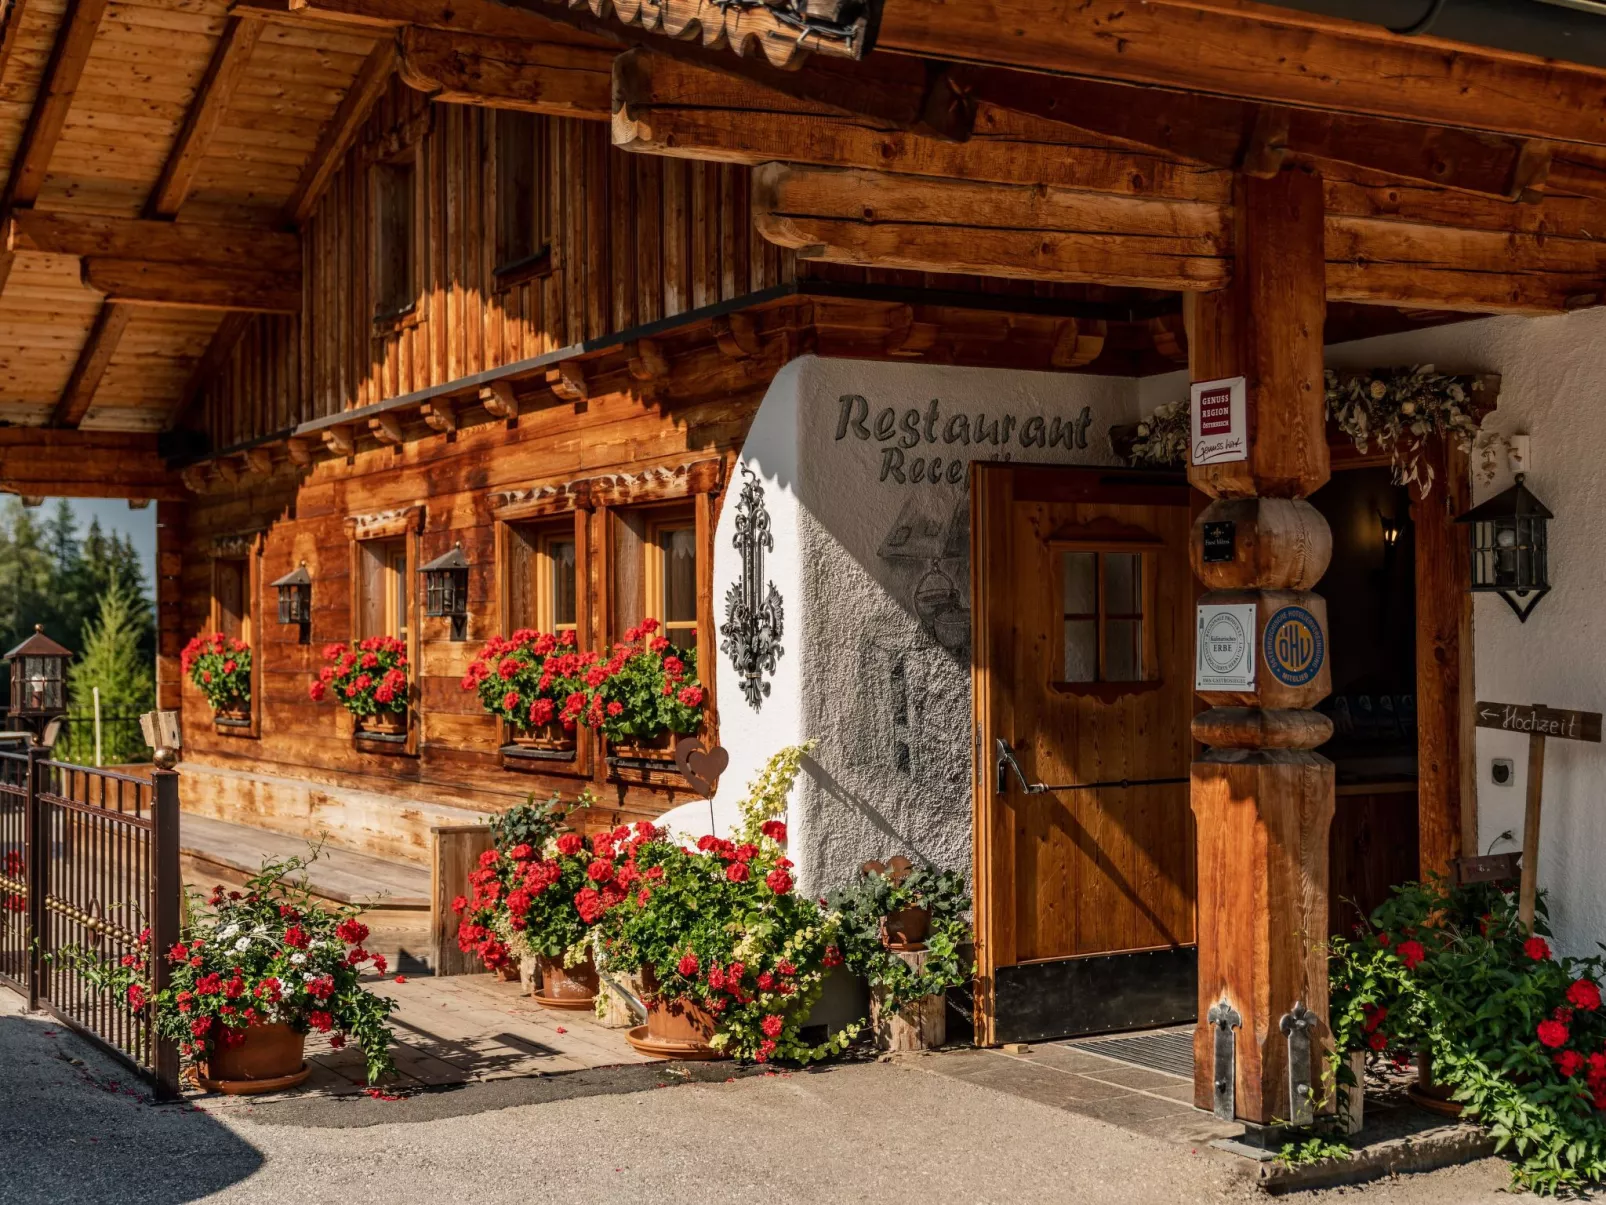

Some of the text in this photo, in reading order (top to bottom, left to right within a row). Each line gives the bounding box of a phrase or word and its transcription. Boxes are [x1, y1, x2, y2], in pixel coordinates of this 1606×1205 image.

[1202, 394, 1229, 405] GENUSS
[1202, 407, 1229, 418] REGION
[834, 394, 1092, 450] Restaurant
[1194, 440, 1224, 460] Genuss
[1213, 644, 1232, 652] ERBE
[1502, 705, 1575, 737] Hochzeit
